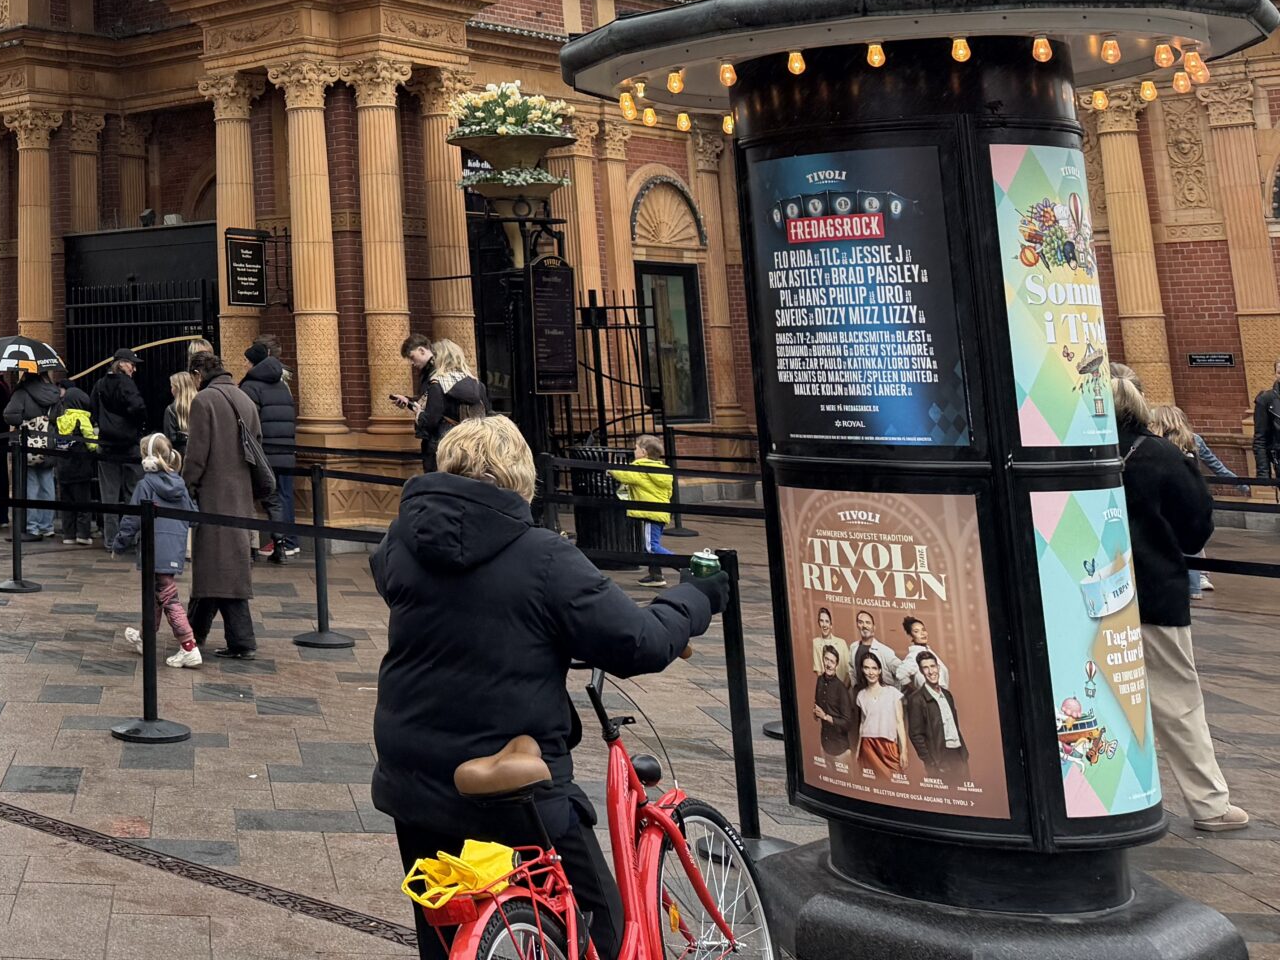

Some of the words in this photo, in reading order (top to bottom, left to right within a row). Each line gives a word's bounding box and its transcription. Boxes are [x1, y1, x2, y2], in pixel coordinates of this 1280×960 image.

[806, 170, 847, 184] TIVOLI
[790, 216, 881, 241] FREDAGSROCK
[543, 259, 562, 267] TIVOLI
[773, 251, 789, 269] FLO
[790, 249, 814, 268] RIDA
[819, 247, 841, 266] TLC
[849, 245, 892, 265] JESSIE
[895, 244, 903, 263] J
[768, 271, 788, 289] RICK
[788, 268, 823, 288] ASTLEY
[831, 267, 864, 286] BRAD
[867, 264, 919, 284] PAISLEY
[780, 289, 793, 307] PIL
[799, 287, 827, 306] HANS
[829, 286, 867, 305] PHILIP
[876, 285, 903, 304] URO
[775, 308, 808, 327] SAVEUS
[814, 307, 846, 326] DIZZY
[848, 306, 880, 325] MIZZ
[882, 305, 917, 324] LIZZY
[1043, 311, 1057, 344] i
[796, 332, 810, 344] TV-2
[815, 331, 838, 344] JONAH
[839, 330, 890, 343] BLACKSMITH
[896, 330, 926, 342] BLÆST
[812, 345, 842, 357] BURHAN
[843, 344, 849, 356] G
[854, 344, 879, 356] DREW
[880, 343, 929, 356] SYCAMORE
[805, 358, 818, 369] ZAR
[819, 357, 842, 369] PAULO
[847, 356, 910, 370] KATINKA/LORD
[911, 356, 933, 369] SIVA
[794, 370, 816, 383] SAINTS
[817, 370, 827, 382] GO
[827, 370, 899, 383] MACHINE/SPLEEN
[900, 370, 933, 383] UNITED
[848, 383, 872, 396] MADS
[873, 383, 908, 396] LANGER
[842, 420, 867, 428] ROYAL
[837, 510, 881, 524] TIVOLI
[816, 529, 848, 539] SOMMERENS
[879, 533, 914, 543] TRADITION
[807, 537, 930, 573] TIVOLI
[802, 562, 948, 602] REVYEN
[825, 594, 852, 605] PREMIERE
[856, 598, 891, 609] GLASSALEN
[892, 601, 899, 609] 4.
[900, 601, 916, 610] JUNI
[1102, 629, 1127, 648] Tag
[1107, 652, 1122, 665] en
[1123, 647, 1137, 663] tur
[892, 773, 908, 781] NIELS
[923, 777, 944, 785] MIKKEL
[873, 788, 896, 797] BILLETTEN
[896, 791, 910, 799] GIVER
[923, 795, 944, 804] ADGANG
[724, 826, 744, 852] KENDA
